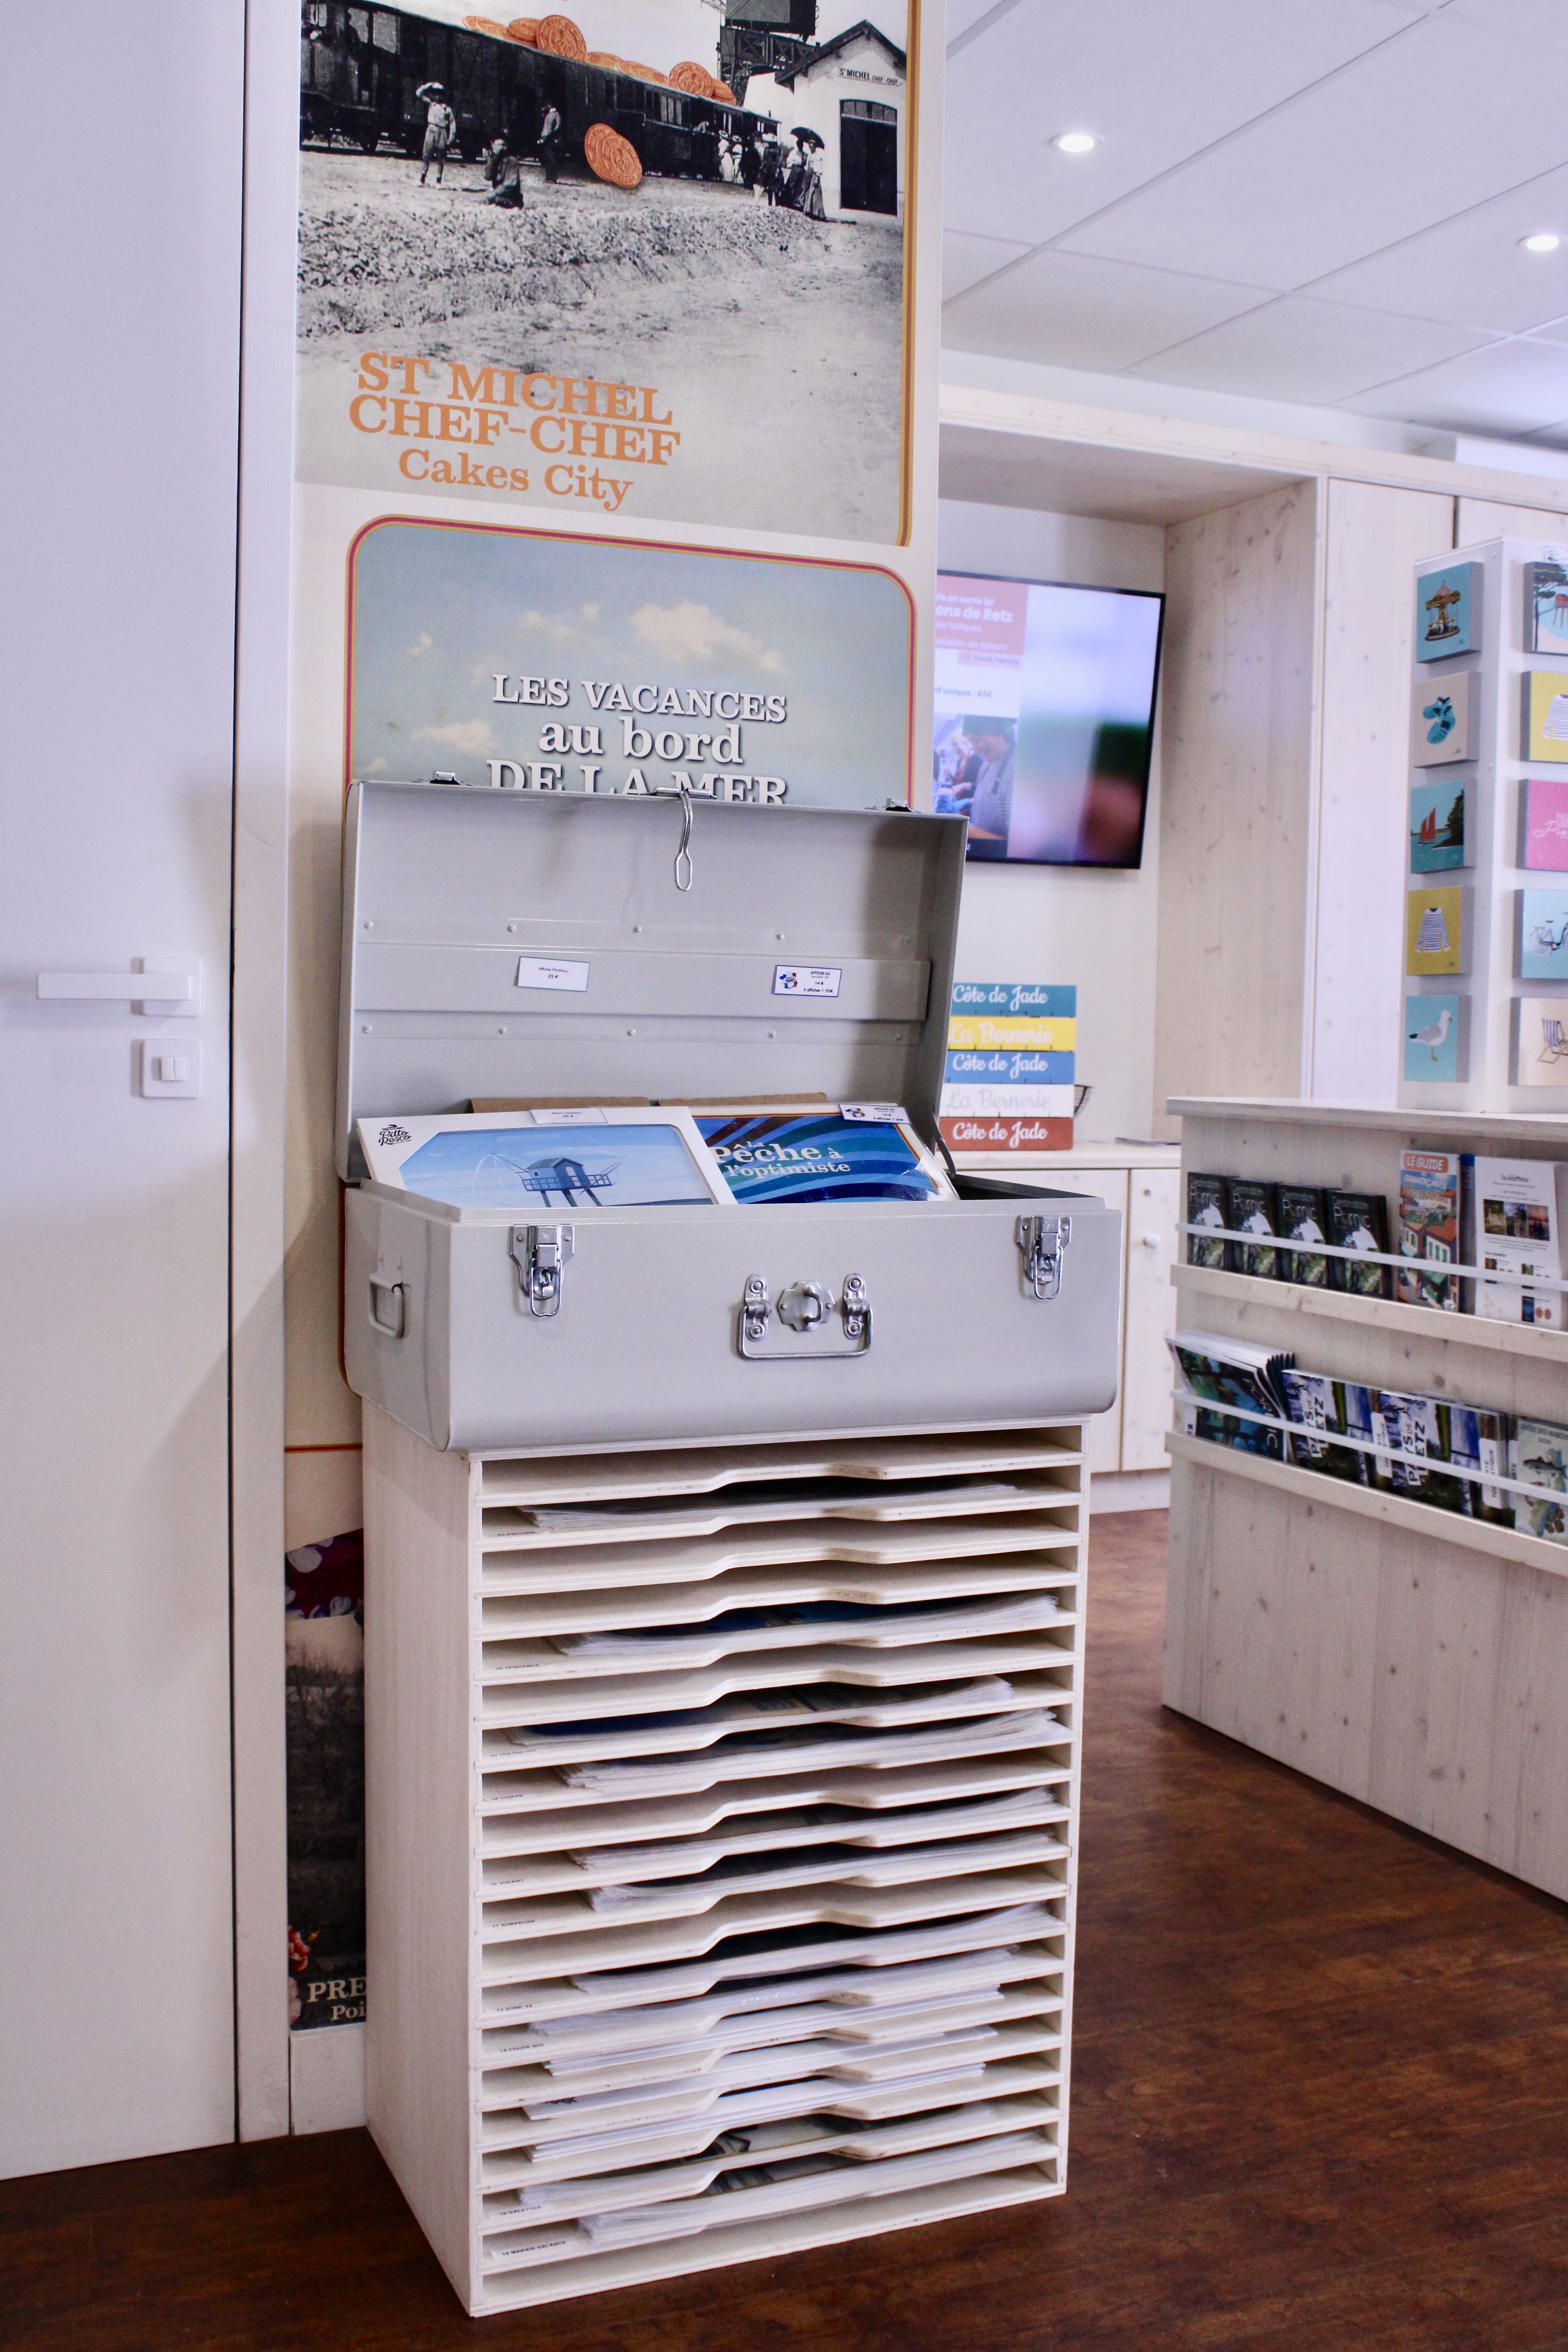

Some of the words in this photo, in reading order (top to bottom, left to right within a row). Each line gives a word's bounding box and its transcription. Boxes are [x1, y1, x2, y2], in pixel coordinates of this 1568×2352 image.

[847, 69, 870, 80] MICHEL
[359, 352, 429, 395] ST
[448, 362, 673, 425] MICHEL
[349, 394, 681, 466] CHEF-CHEF
[399, 448, 529, 492] Cakes
[544, 464, 633, 512] City
[963, 606, 981, 620] de
[983, 608, 1013, 623] Retz
[492, 674, 569, 707] LES
[581, 680, 786, 723] VACANCES
[943, 687, 971, 698] unique
[539, 722, 603, 754] au
[619, 715, 744, 764] bord
[486, 759, 563, 790] DE
[579, 764, 652, 795] LA
[671, 771, 786, 805] MER
[953, 985, 986, 1004] Côte
[988, 985, 1008, 1004] de
[1009, 985, 1048, 1011] Jade
[948, 1022, 975, 1044] La
[978, 1021, 1054, 1045] Bernerie
[953, 1053, 986, 1071] Côte
[988, 1054, 1008, 1071] de
[1009, 1054, 1048, 1079] Jade
[946, 1088, 972, 1110] La
[976, 1088, 1051, 1110] Bernerie
[378, 1135, 412, 1146] Resco
[379, 1129, 409, 1139] Pitto
[952, 1122, 986, 1140] Côte
[988, 1122, 1008, 1140] de
[1009, 1121, 1048, 1149] Jade
[708, 1143, 822, 1163] Pêche
[828, 1147, 844, 1159] à
[1407, 1155, 1416, 1167] LE
[1416, 1157, 1444, 1171] GUIDE
[724, 1161, 851, 1179] l'optimiste
[508, 2205, 542, 2214] GALETTES
[511, 2246, 535, 2254] MARAIS
[537, 2241, 566, 2249] SALANTS
